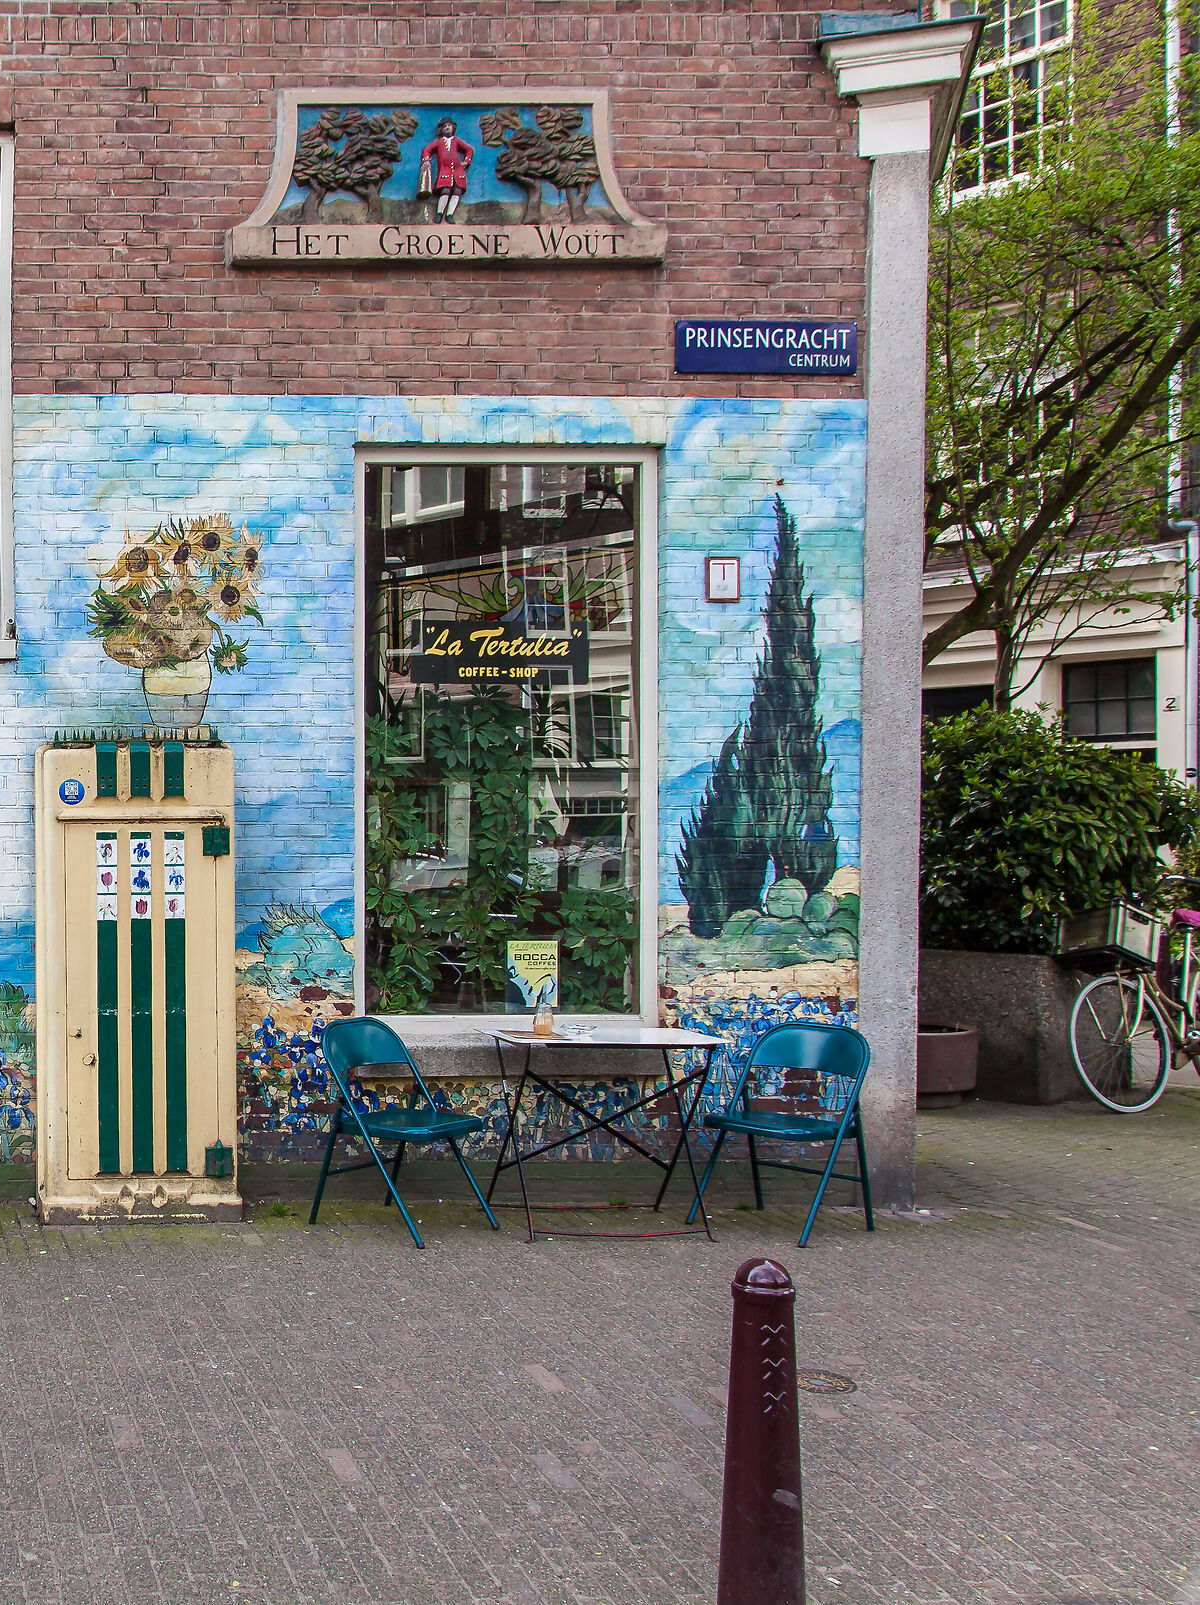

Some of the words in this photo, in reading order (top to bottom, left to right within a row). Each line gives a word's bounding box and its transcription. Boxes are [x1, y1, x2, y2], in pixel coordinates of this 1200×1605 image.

[271, 226, 349, 255] HET
[379, 226, 510, 255] GROENE
[686, 327, 851, 350] PRINSENGRACHT
[788, 353, 850, 367] CENTRUM
[1166, 697, 1177, 709] 2
[514, 953, 557, 961] BOCCA
